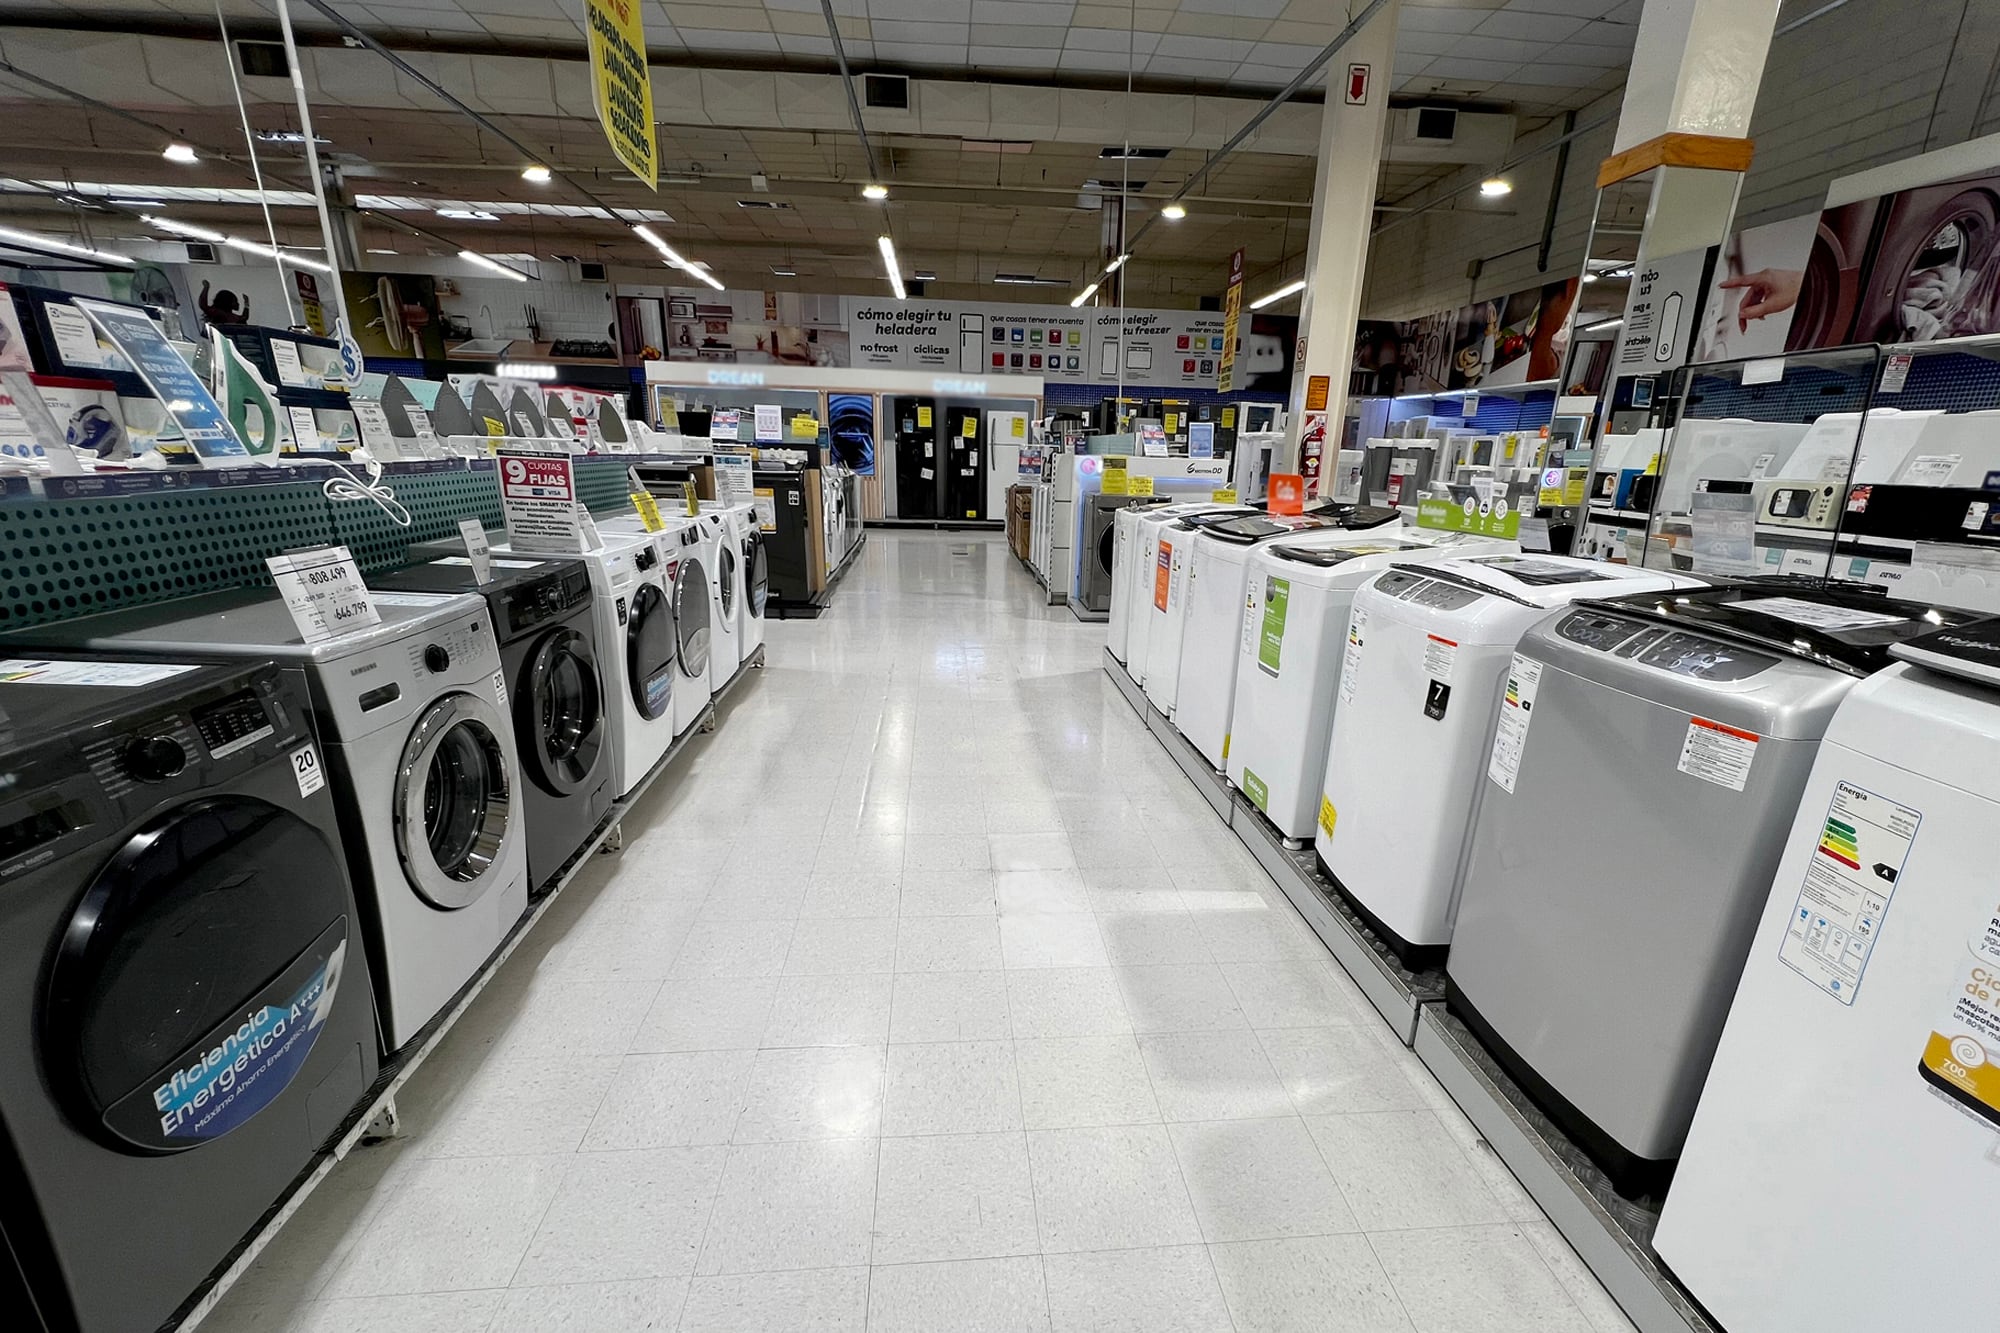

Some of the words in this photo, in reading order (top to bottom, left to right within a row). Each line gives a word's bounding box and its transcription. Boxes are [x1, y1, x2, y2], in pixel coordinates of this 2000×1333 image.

[857, 308, 895, 323] cómo
[896, 309, 936, 323] elegir
[937, 310, 952, 322] tu
[990, 315, 1005, 324] que
[1028, 316, 1047, 324] tener
[1059, 317, 1084, 326] cuenta
[1127, 314, 1158, 327] elegir
[875, 322, 937, 336] heladera
[1123, 326, 1134, 336] tu
[1134, 326, 1171, 336] freezer
[1195, 320, 1208, 328] que
[860, 344, 873, 353] no
[874, 343, 899, 353] frost
[913, 344, 951, 355] cíclicas
[505, 460, 527, 484] 9
[527, 463, 562, 471] CUOTAS
[529, 474, 566, 486] FIJAS
[309, 567, 347, 585] 808.499
[335, 601, 368, 620] 646.799
[1435, 684, 1444, 700] 7
[296, 750, 314, 772] 20
[1839, 783, 1868, 801] Energía
[1980, 943, 1987, 951] y
[1965, 982, 1989, 1000] de
[1953, 1012, 1964, 1021] un
[1966, 1017, 1986, 1034] 80%
[153, 1005, 269, 1111] Eficiencia
[160, 1019, 286, 1136] Energética
[290, 983, 321, 1025] A+++
[1943, 1058, 1967, 1078] 700
[194, 1094, 234, 1133] Máximo
[235, 1065, 267, 1095] Ahorro
[267, 1024, 307, 1067] Energético
